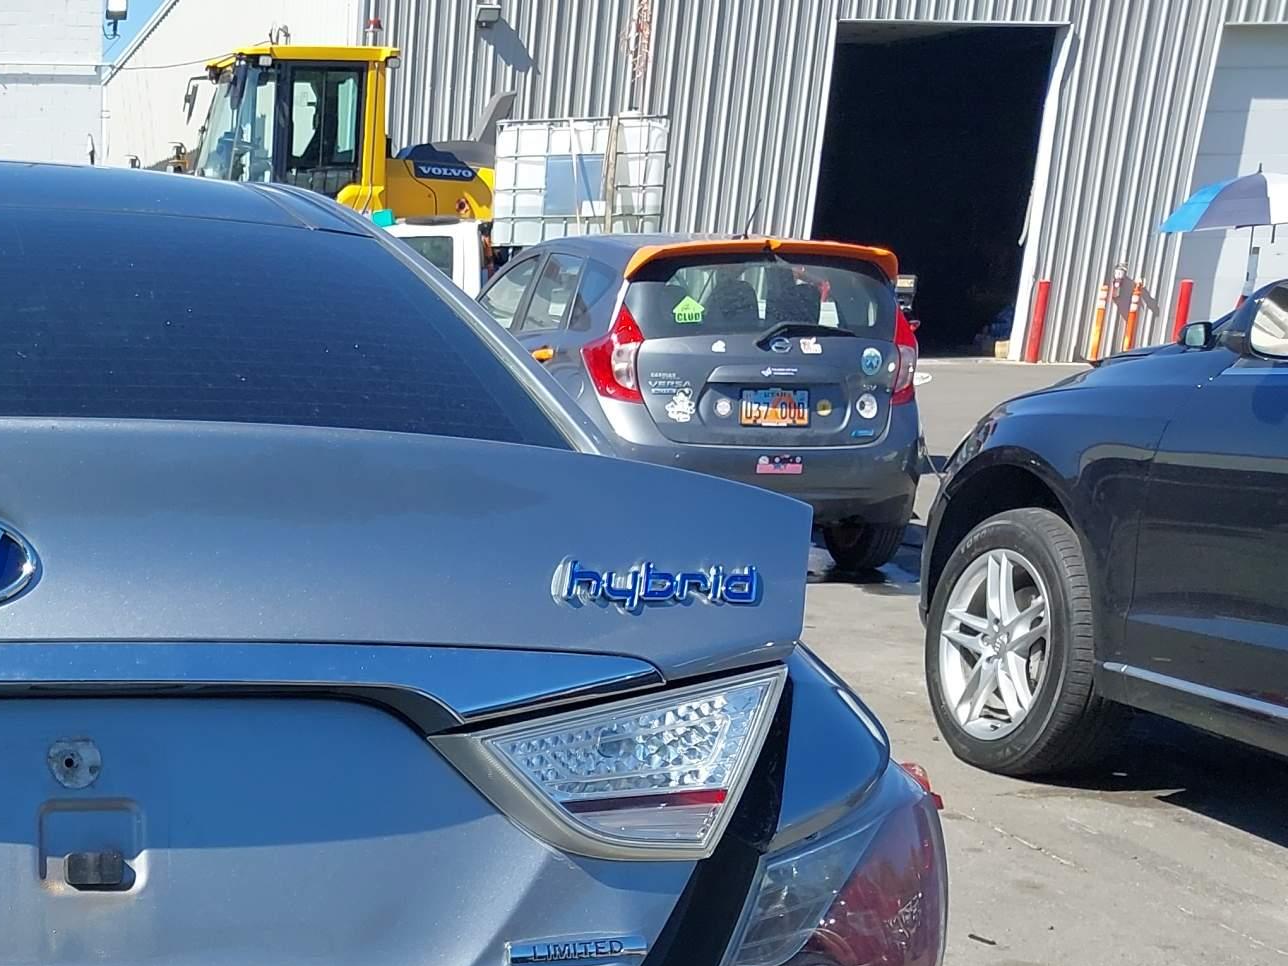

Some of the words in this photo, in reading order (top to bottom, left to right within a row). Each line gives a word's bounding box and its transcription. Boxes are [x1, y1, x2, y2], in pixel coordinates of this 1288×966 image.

[418, 166, 473, 178] VOLVO
[648, 380, 691, 388] VERSA
[560, 558, 760, 613] hybrid
[531, 940, 624, 961] LIMITED
